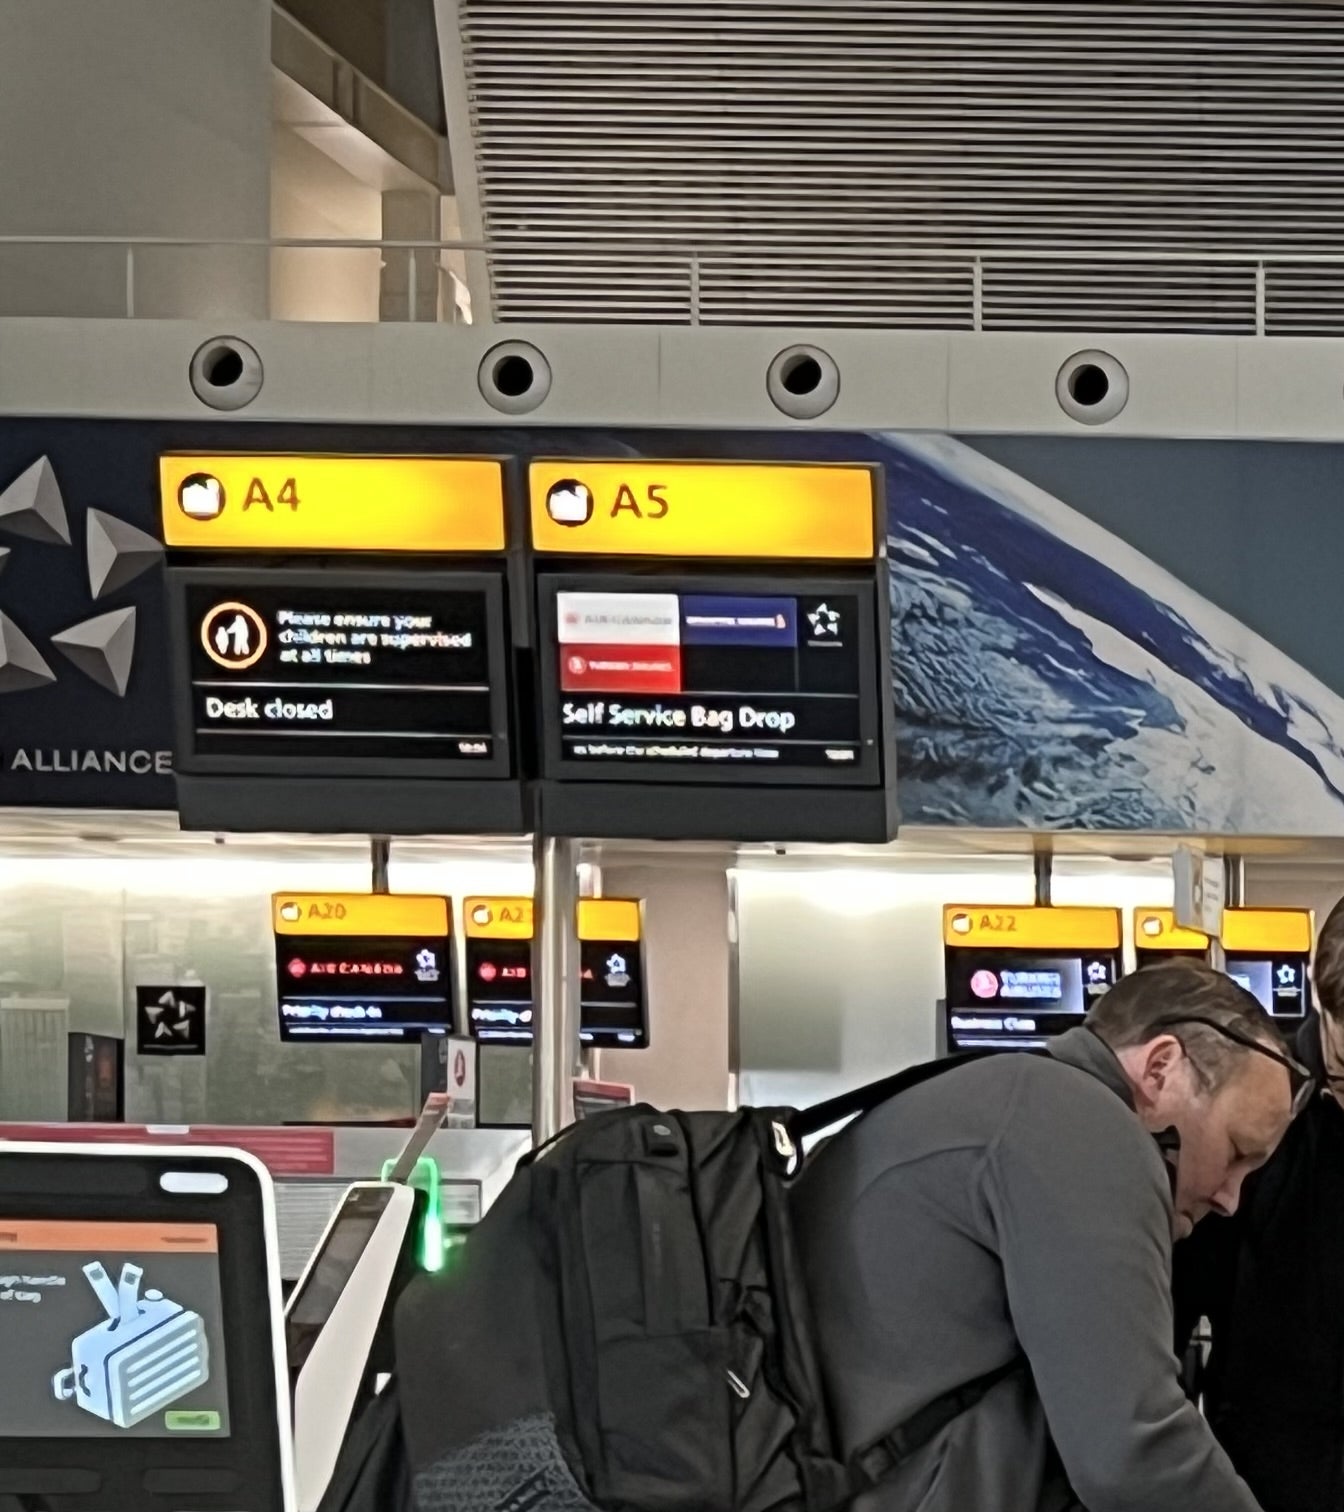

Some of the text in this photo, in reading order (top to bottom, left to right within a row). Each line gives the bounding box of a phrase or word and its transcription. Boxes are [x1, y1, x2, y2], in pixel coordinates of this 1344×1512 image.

[241, 477, 300, 513] A4
[610, 484, 669, 519] A5
[206, 697, 333, 721] Desk closed
[562, 702, 796, 734] Self Service Bag Drop
[10, 748, 174, 775] ALLIANCE
[500, 907, 523, 923] A2
